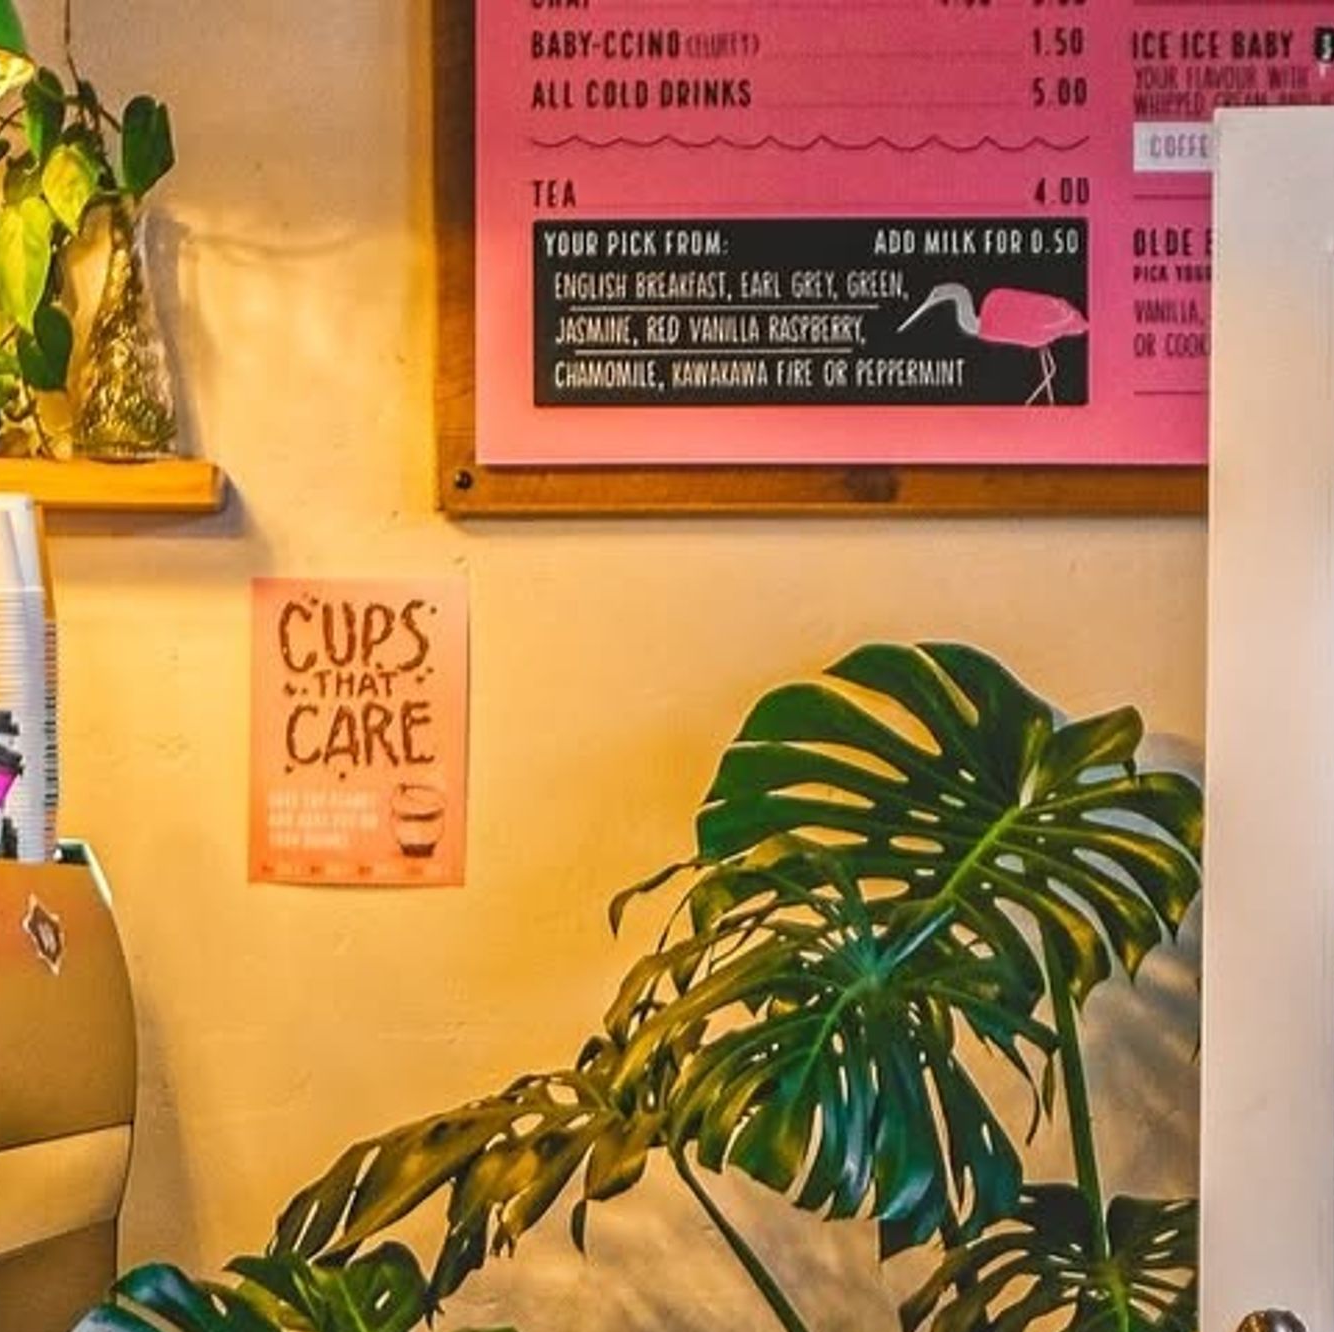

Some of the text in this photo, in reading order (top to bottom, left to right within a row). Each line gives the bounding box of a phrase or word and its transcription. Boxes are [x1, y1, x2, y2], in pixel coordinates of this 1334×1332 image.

[531, 30, 679, 59] BABY-CCINO
[1033, 28, 1083, 56] 1.50
[1132, 31, 1293, 59] ICE ICE BABY
[1033, 77, 1087, 106] 5.00
[1135, 67, 1309, 90] YOUR FLAVOUR WITH
[531, 80, 751, 109] ALL COLD DRINKS
[533, 180, 575, 208] TEA
[1035, 178, 1089, 205] 4.00
[545, 231, 727, 256] YOUR PICK FROM:
[875, 229, 1078, 254] ADD MILK FOR 0.50
[1134, 228, 1191, 257] OLDE
[555, 270, 908, 301] ENGLISH BREAKFAST, EARL GREY, GREEN,
[1133, 265, 1168, 282] PICK
[1134, 298, 1204, 325] VANILLA,
[556, 315, 865, 346] JASMINE, RED VANILLA RASPBERRY,
[1133, 332, 1157, 357] OR
[555, 359, 963, 390] CHAMOMILE, KAWAKAWA FIRE OR PEPPERMINT
[279, 599, 429, 672] CUPS
[315, 670, 398, 697] THAT
[285, 703, 435, 767] CARE
